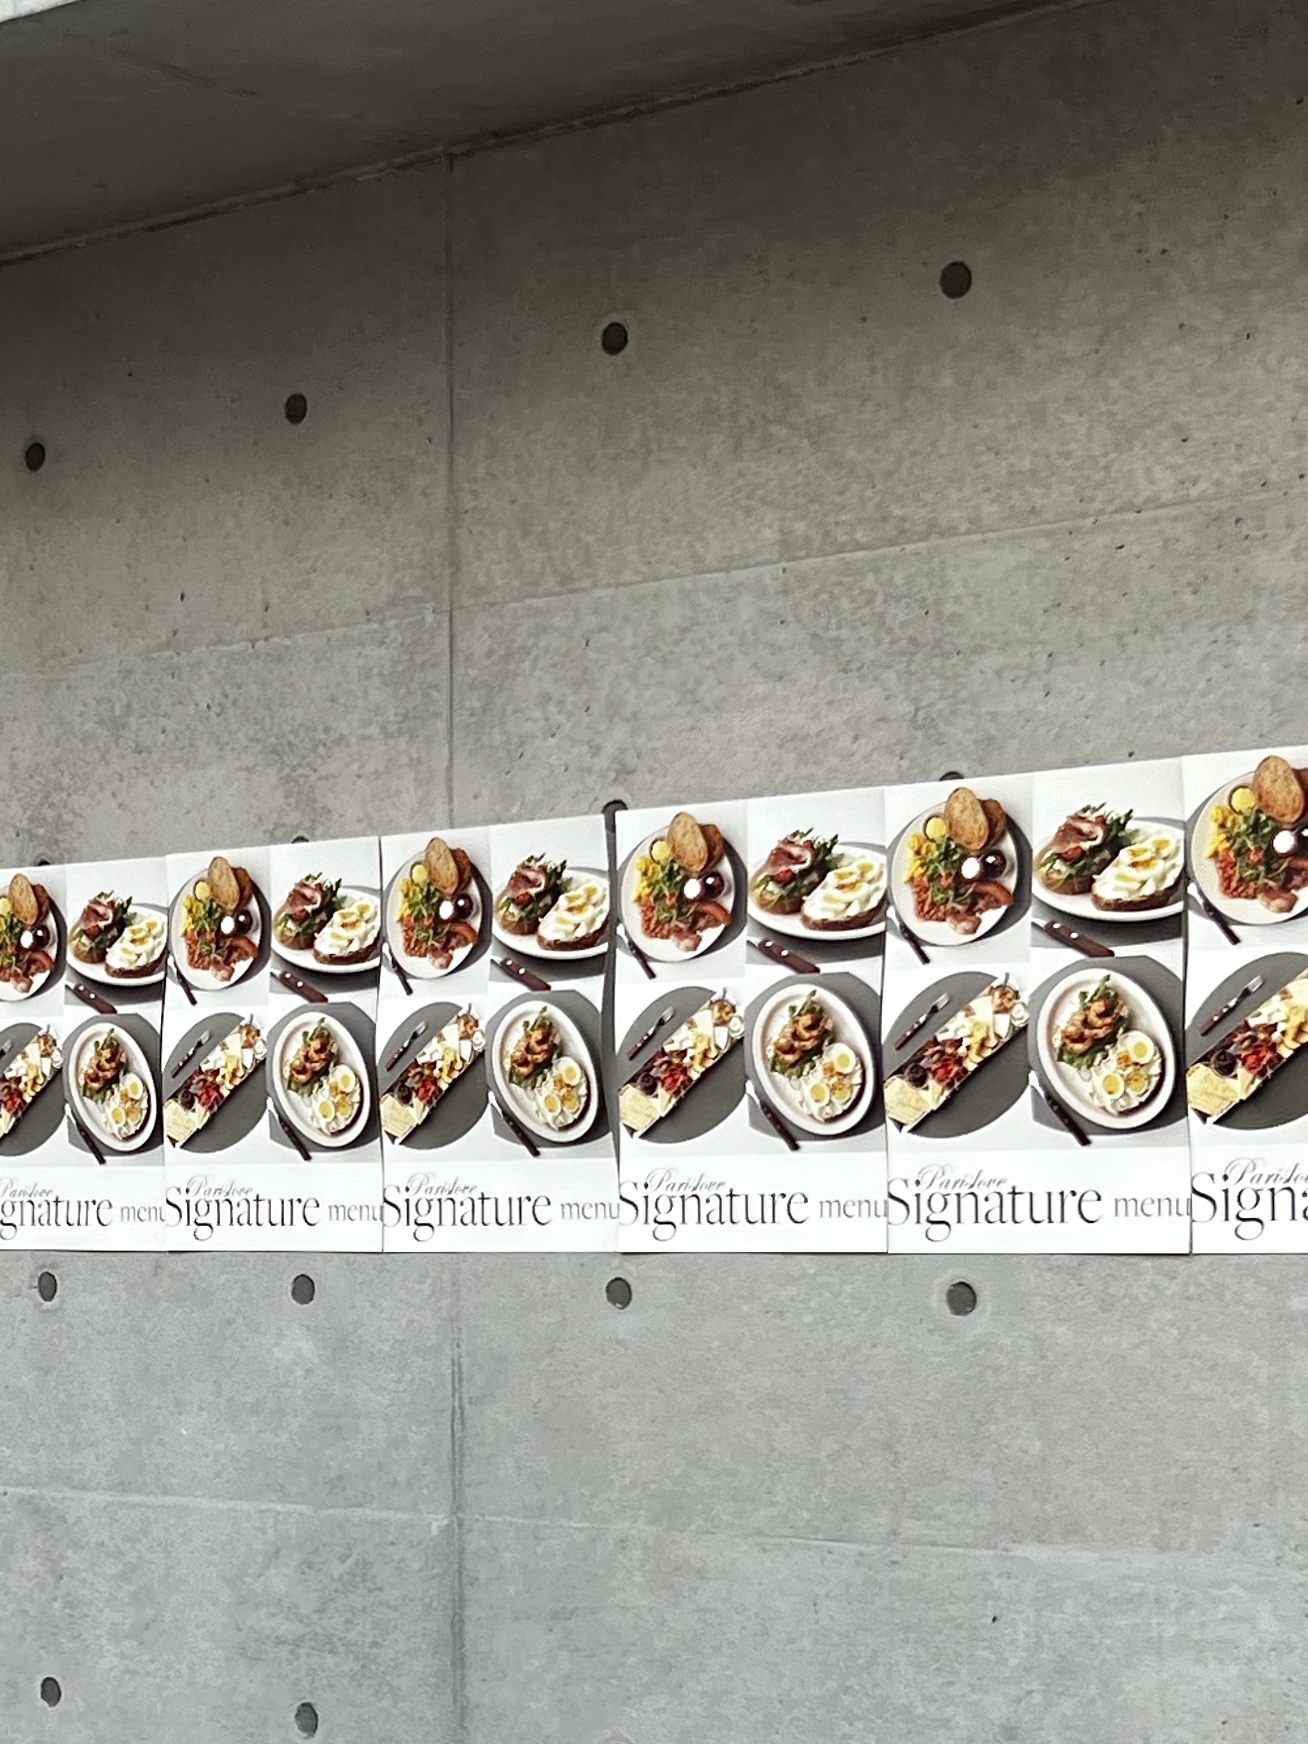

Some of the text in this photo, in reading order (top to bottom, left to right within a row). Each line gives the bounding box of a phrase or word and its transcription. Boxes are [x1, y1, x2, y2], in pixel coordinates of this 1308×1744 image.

[166, 1186, 384, 1241] Signature menu
[383, 1184, 620, 1242] Signature menu
[619, 1180, 888, 1242] Signature menu
[887, 1177, 1190, 1242] Signature menu
[1192, 1171, 1308, 1241] Sign
